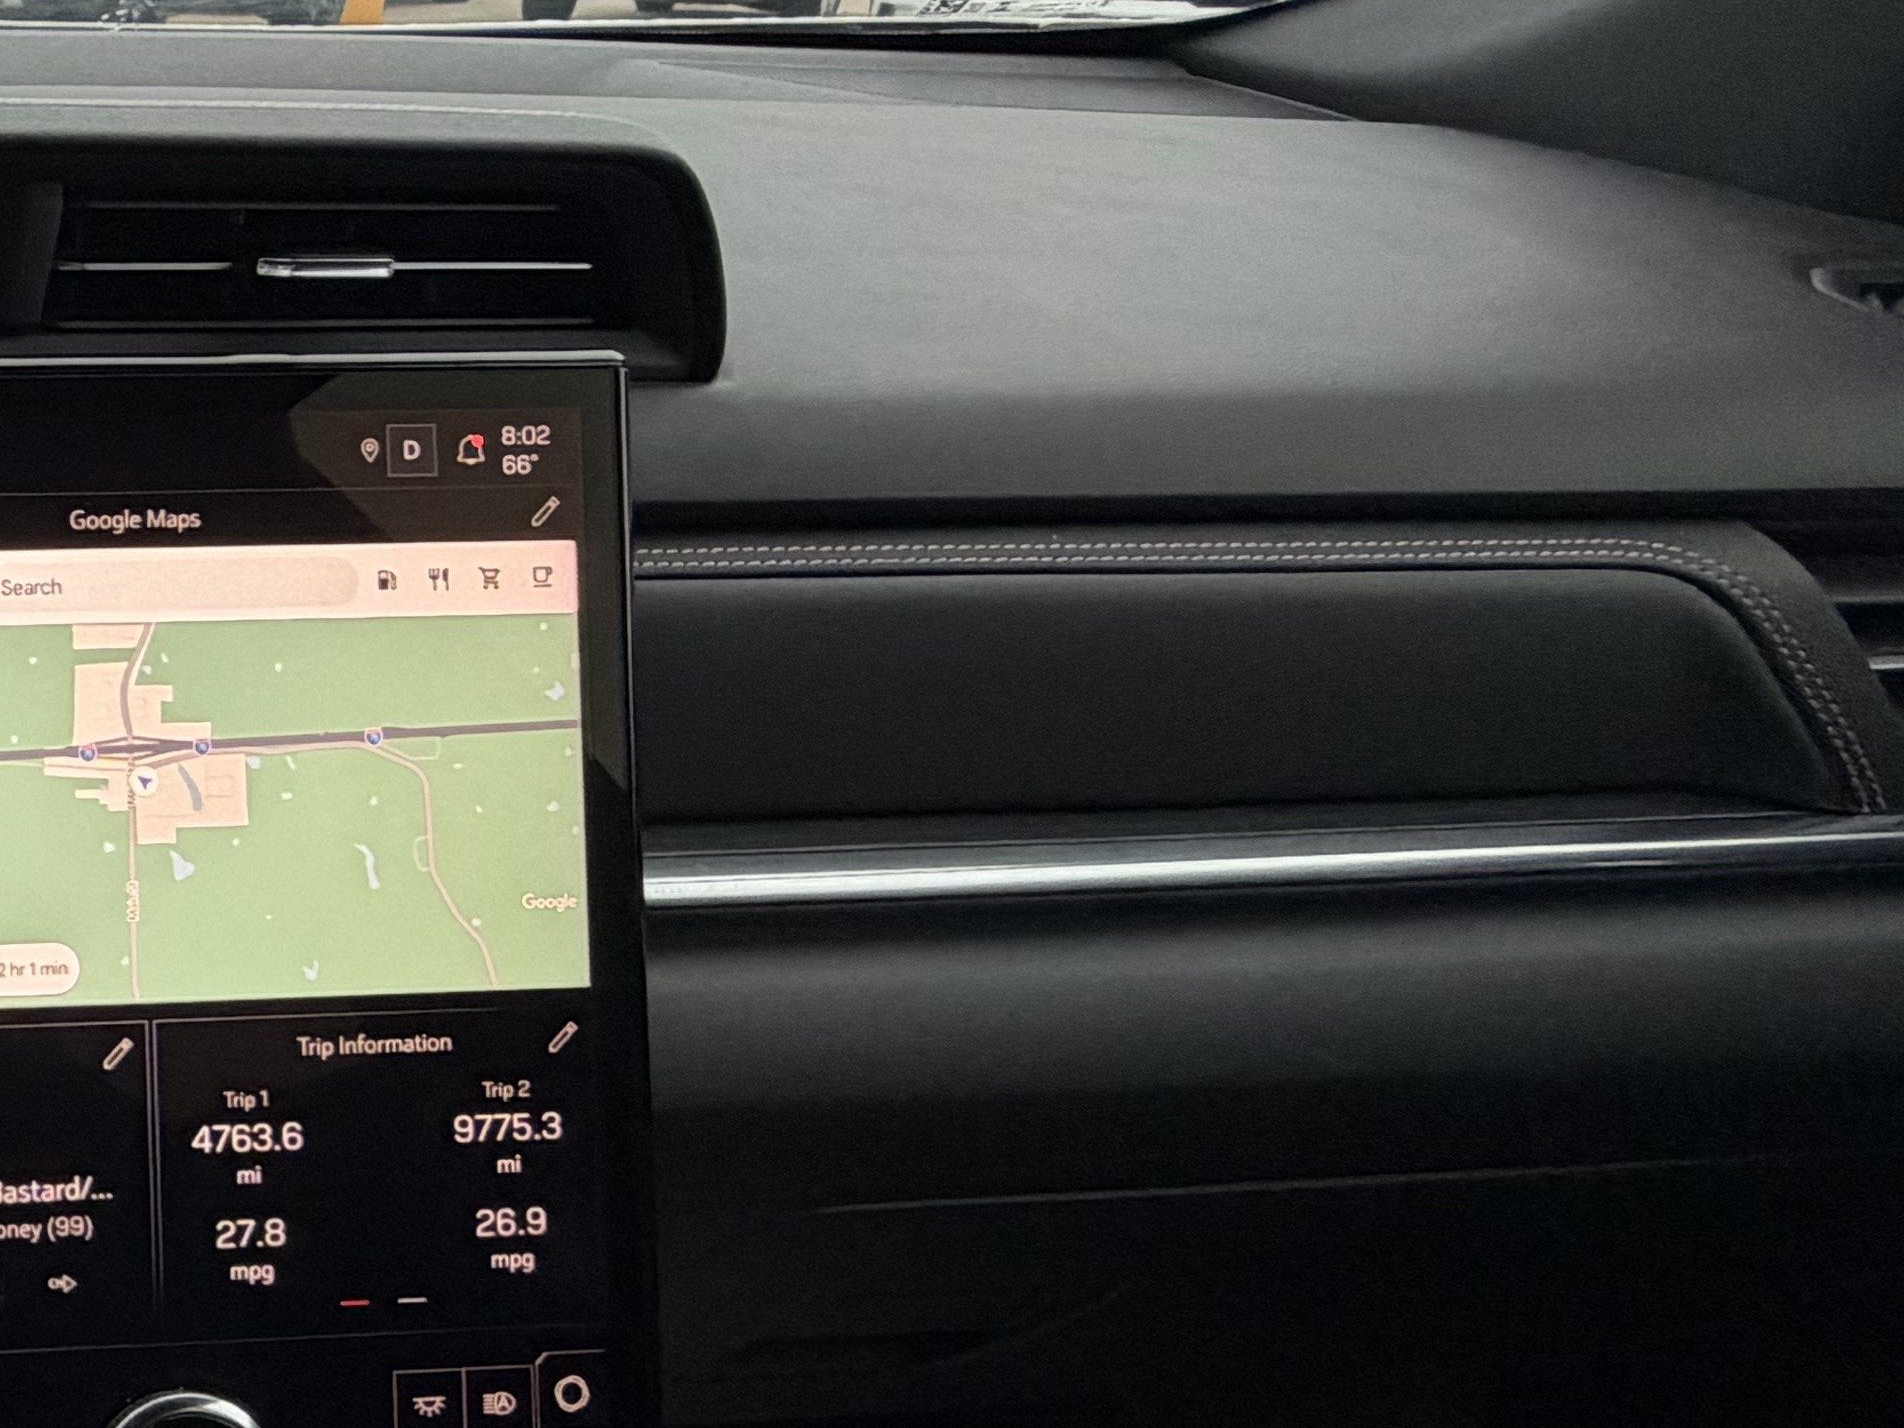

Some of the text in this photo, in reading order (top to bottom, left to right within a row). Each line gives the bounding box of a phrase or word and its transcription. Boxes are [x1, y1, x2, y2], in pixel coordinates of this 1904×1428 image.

[500, 424, 552, 447] 8:02
[402, 439, 422, 461] D
[501, 452, 540, 475] 66°
[69, 509, 202, 535] Google Maps
[0, 577, 63, 598] Search
[521, 893, 579, 912] Google
[10, 962, 26, 978] hr
[39, 962, 70, 978] min
[296, 1034, 453, 1060] Trip Information
[223, 1090, 270, 1112] Trip 1
[481, 1080, 531, 1102] Trip 2
[191, 1122, 304, 1154] 4763.6
[453, 1111, 563, 1144] 9775.3
[236, 1165, 262, 1185] mi
[496, 1154, 523, 1174] mi
[46, 1215, 94, 1241] (99)
[475, 1206, 548, 1238] 26.9
[215, 1218, 287, 1250] 27.8
[490, 1252, 535, 1274] mpg
[229, 1264, 275, 1286] mpg
